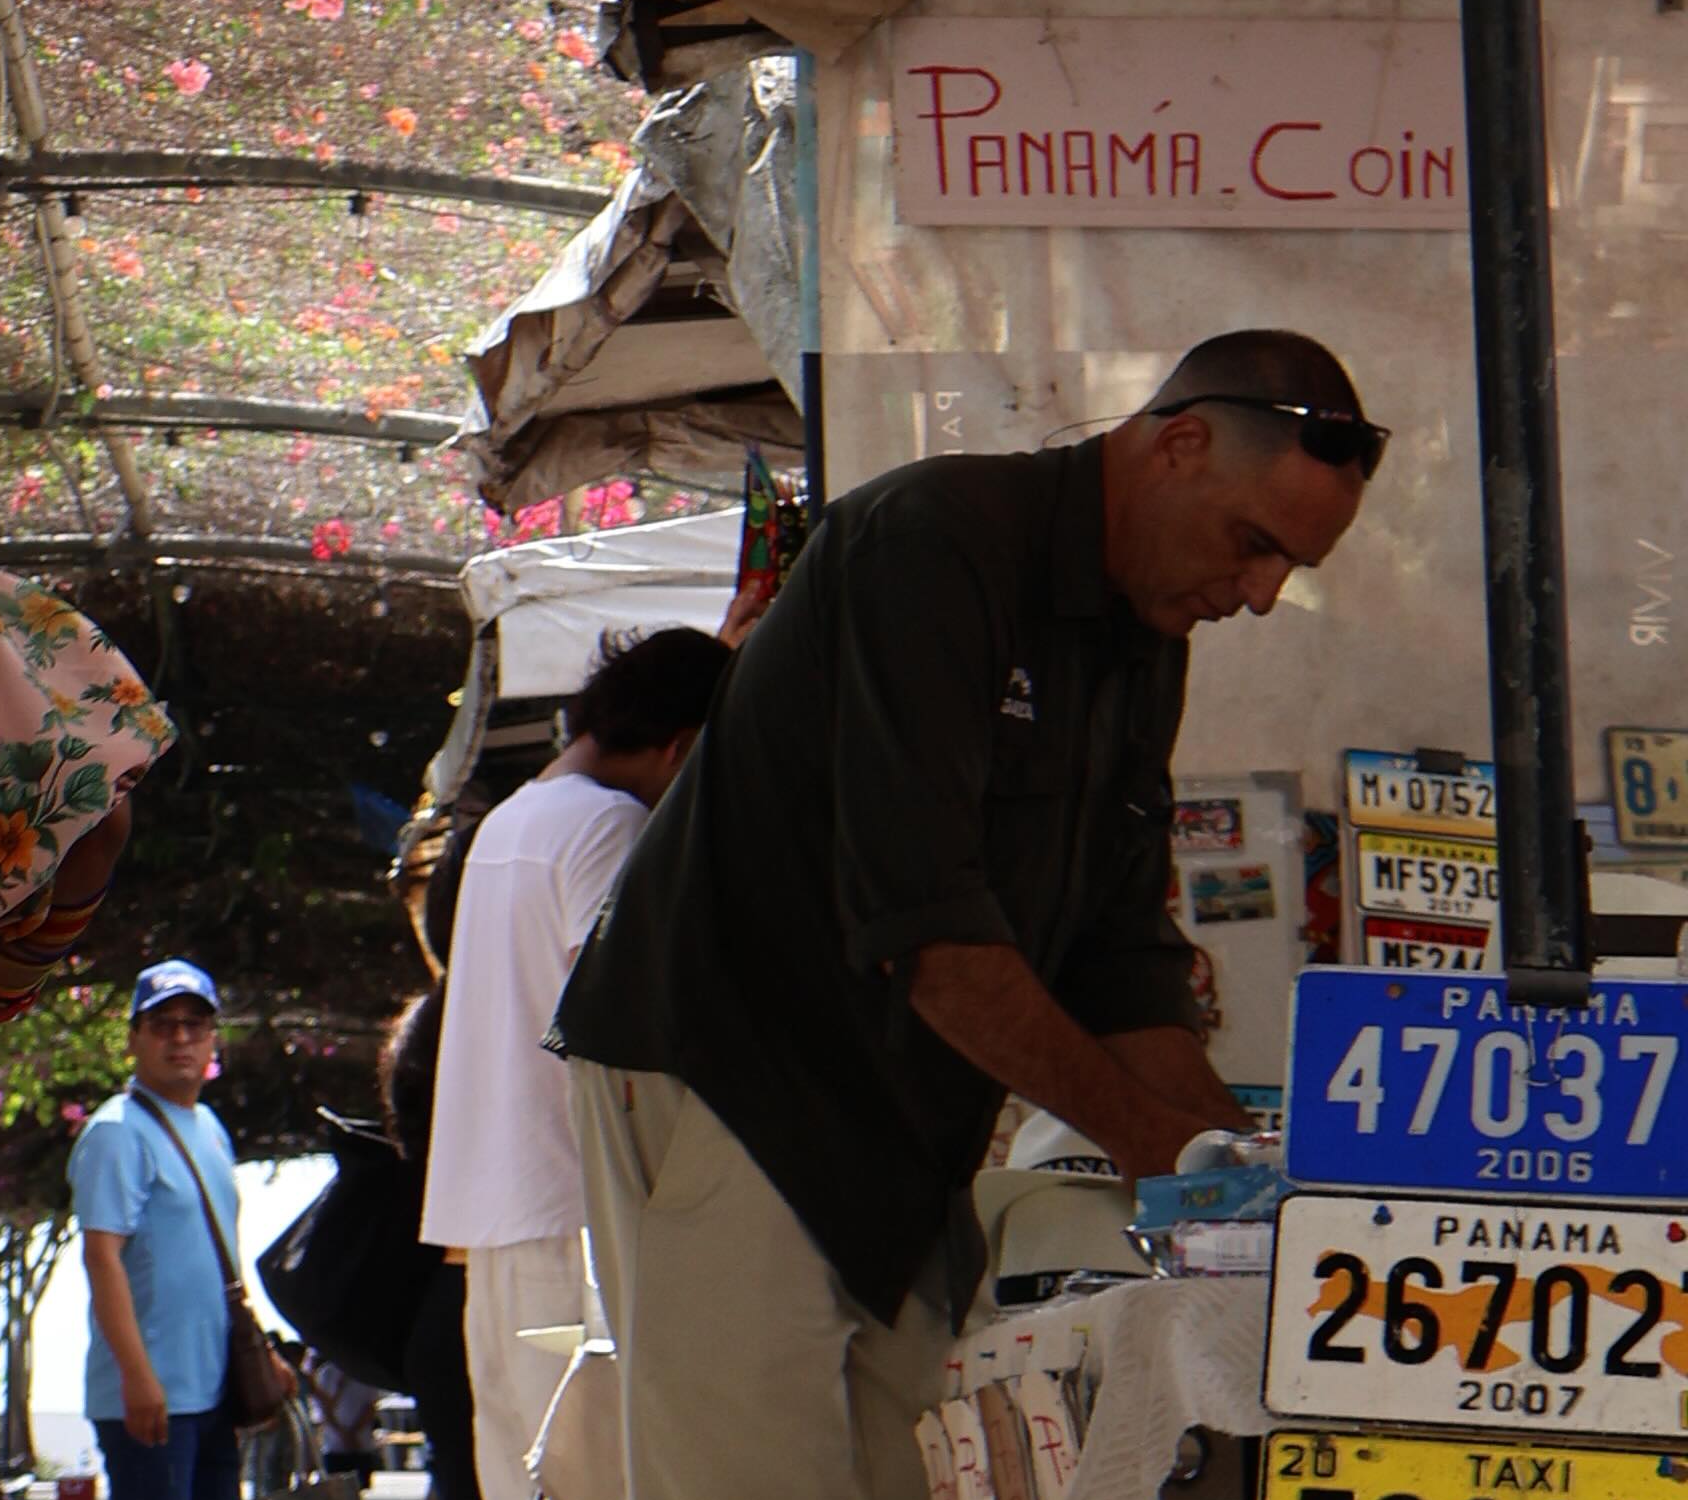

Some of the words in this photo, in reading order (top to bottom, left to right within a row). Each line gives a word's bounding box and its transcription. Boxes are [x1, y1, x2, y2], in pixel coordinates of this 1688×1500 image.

[1327, 1024, 1680, 1146] 47037
[1476, 1148, 1594, 1183] 2006
[1434, 1215, 1622, 1255] PANAMA
[1306, 1252, 1688, 1379] 26702
[1458, 1380, 1586, 1417] 2007
[1468, 1454, 1576, 1494] TAXI
